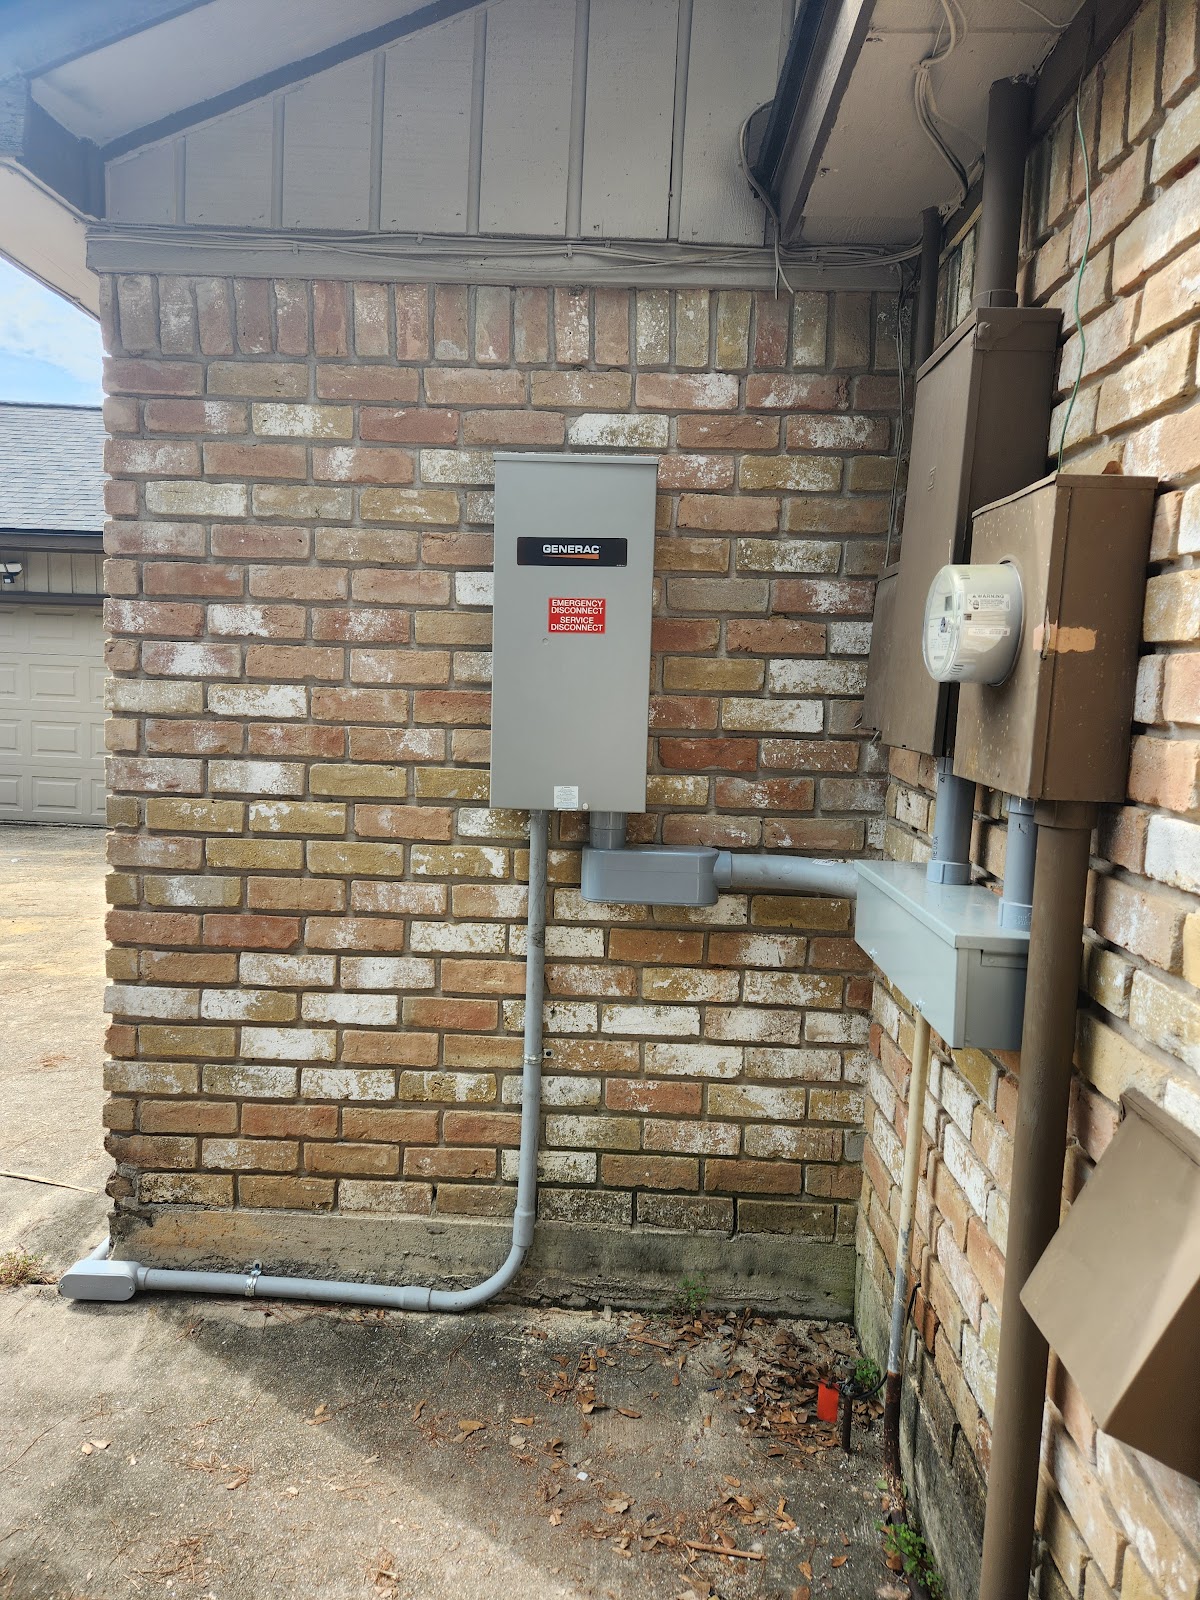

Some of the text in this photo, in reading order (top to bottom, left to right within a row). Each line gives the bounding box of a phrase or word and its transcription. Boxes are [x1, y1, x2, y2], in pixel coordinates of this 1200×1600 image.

[542, 544, 600, 554] GENERAC
[551, 599, 603, 607] EMERGENCY
[551, 607, 604, 615] DISCONNECT
[560, 616, 594, 624] SERVICE
[550, 624, 604, 632] DISCONNECT
